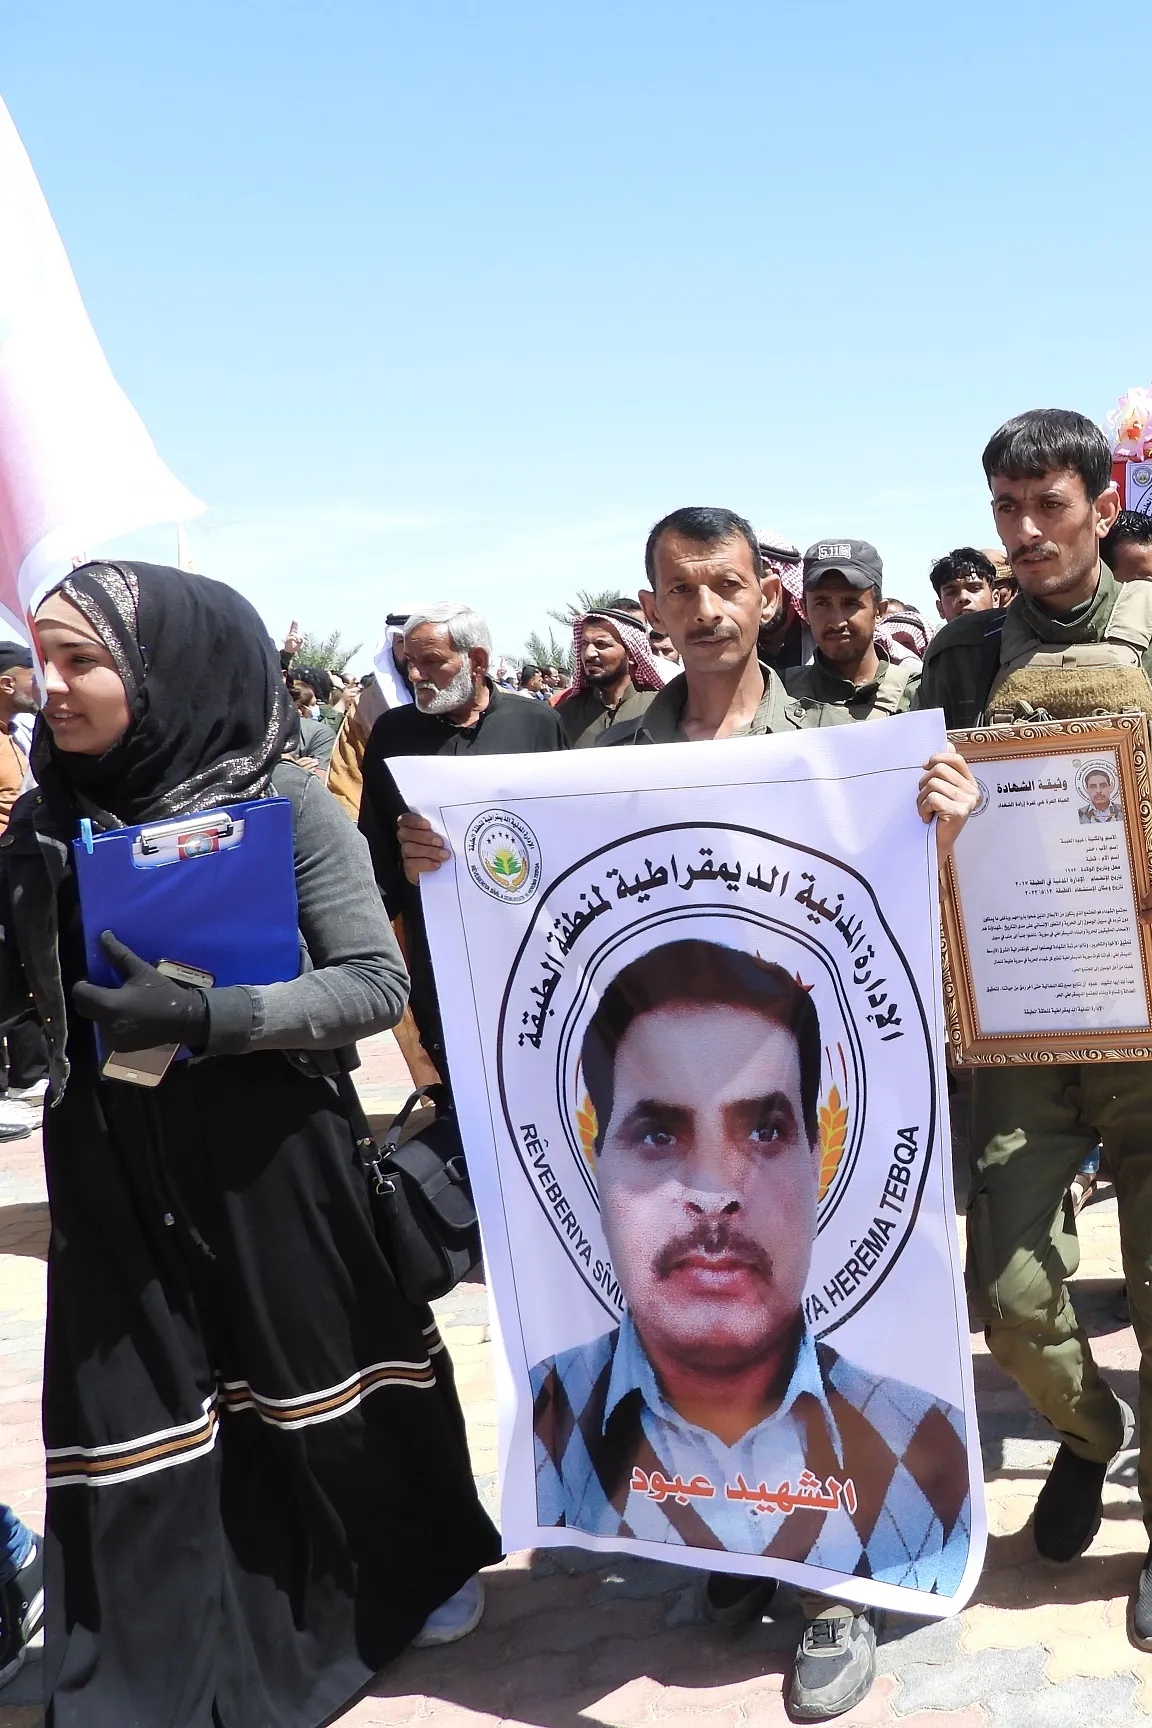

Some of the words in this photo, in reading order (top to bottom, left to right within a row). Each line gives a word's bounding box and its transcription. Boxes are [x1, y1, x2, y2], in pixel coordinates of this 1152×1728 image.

[996, 779, 1034, 793] الشهادة
[1038, 777, 1067, 792] وثيقة
[606, 847, 790, 903] الديمقراطية
[546, 884, 613, 956] لمنطقة
[794, 872, 866, 953] المدنية
[518, 952, 565, 1049] الطبقة
[854, 944, 904, 1041] الإدارة
[520, 1123, 592, 1267] RÊVEBERIYA
[823, 1217, 897, 1307] HERÊMA
[880, 1125, 920, 1214] TEBQA
[630, 1466, 715, 1506] عبود
[725, 1467, 858, 1516] الشهيد
